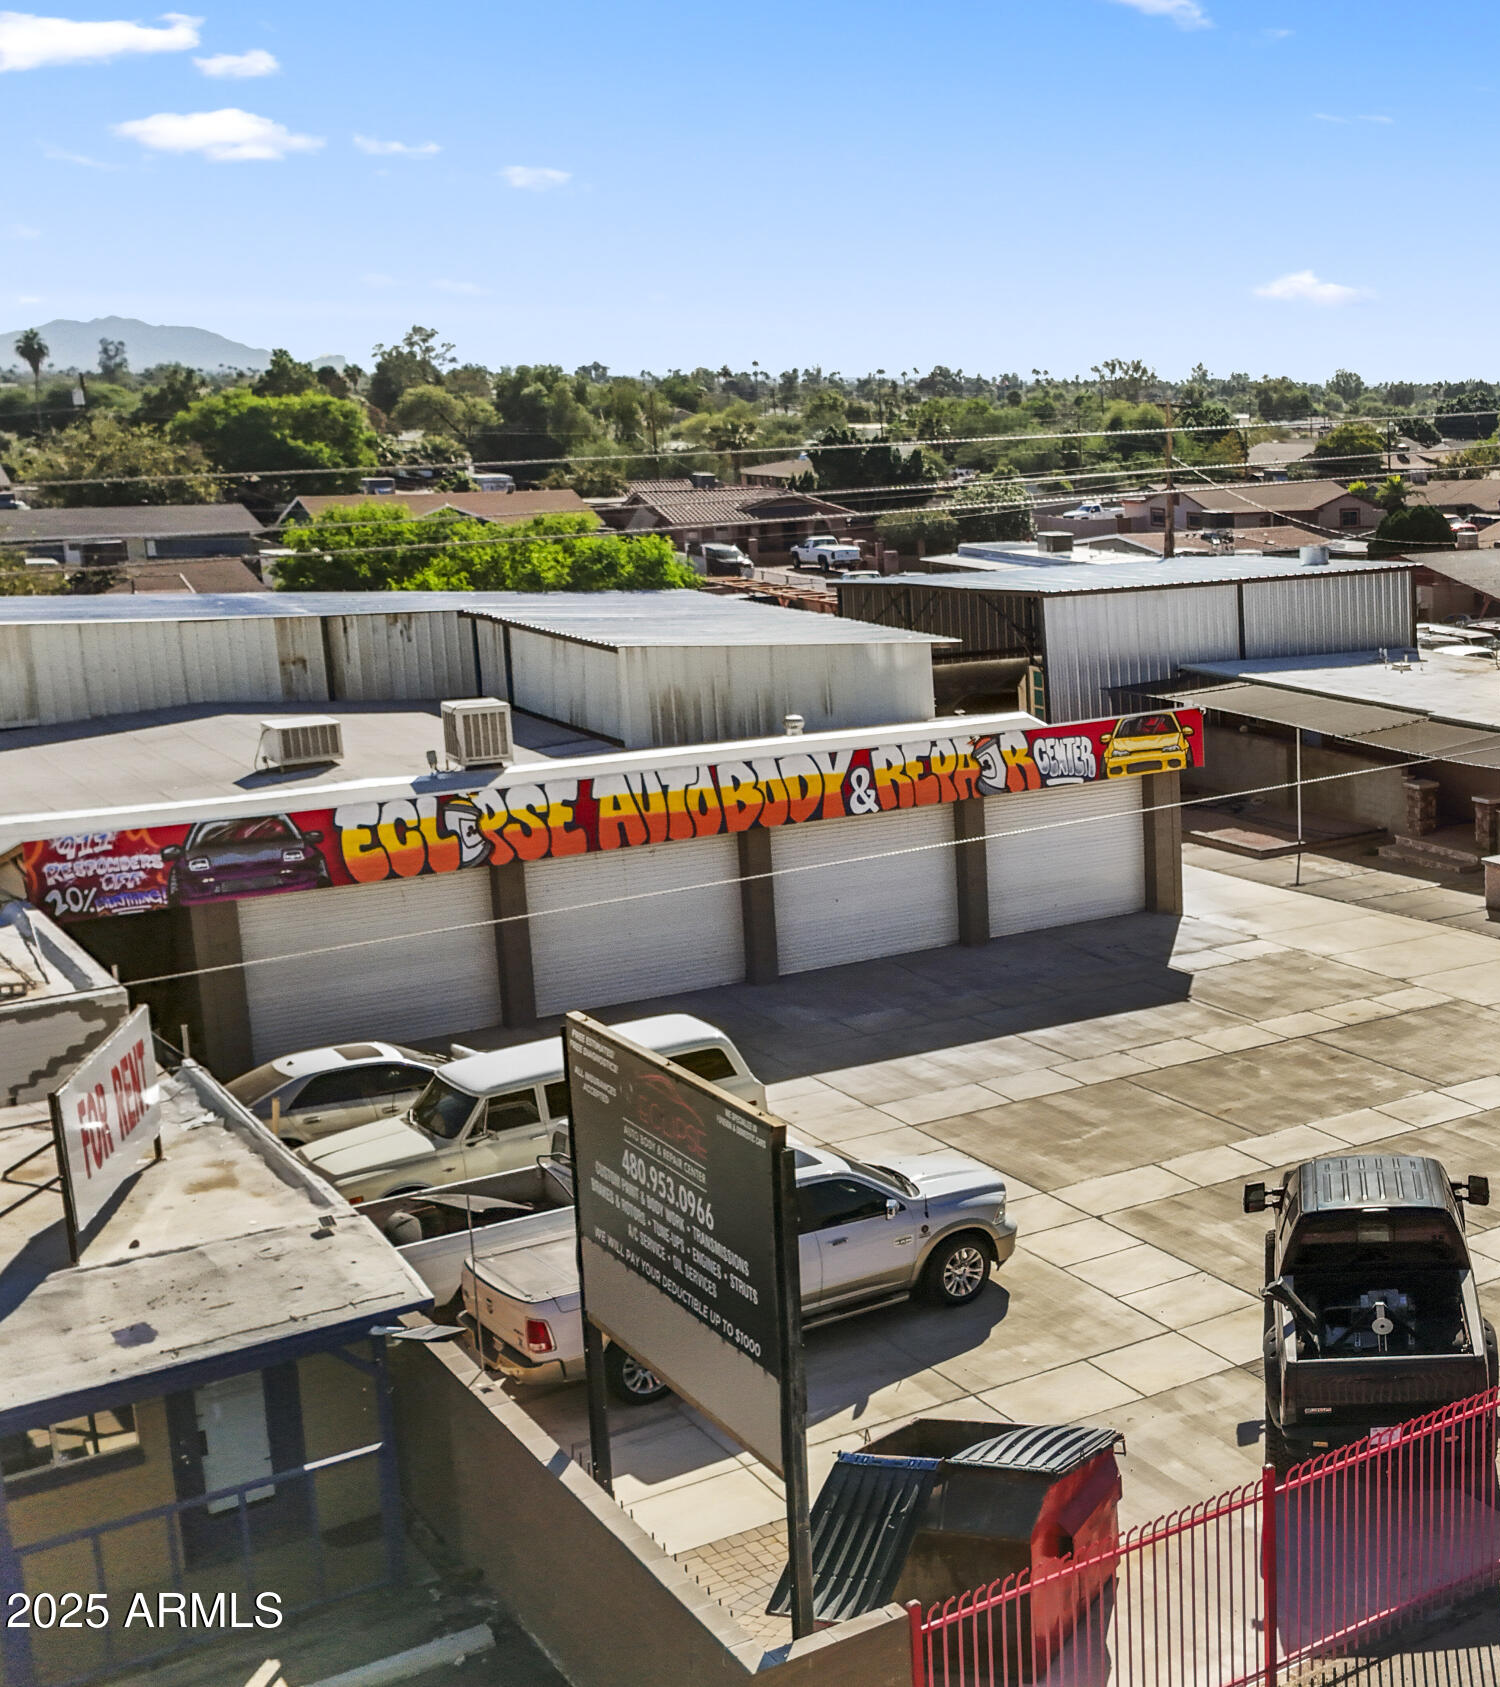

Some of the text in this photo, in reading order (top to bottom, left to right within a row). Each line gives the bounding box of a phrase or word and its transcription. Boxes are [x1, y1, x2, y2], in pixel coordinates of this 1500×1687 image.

[850, 767, 880, 814] &
[1033, 736, 1097, 778] CENTER
[43, 853, 164, 886] RESPONDERS
[45, 886, 97, 916] 20%
[101, 871, 147, 892] OFF
[77, 1038, 150, 1180] FOR RENT
[638, 1095, 708, 1160] ECLIPSE
[623, 1125, 639, 1142] AUTO
[640, 1134, 656, 1152] BODY
[662, 1148, 682, 1169] REPAIR
[684, 1162, 706, 1184] CENTER
[622, 1149, 715, 1231] 480.953.0966
[640, 1230, 666, 1261] SERVICE
[672, 1255, 684, 1274] OIL
[684, 1263, 718, 1298] SERVICES
[664, 1207, 686, 1232] WORK
[692, 1226, 750, 1277] TRANSMISSIONS
[594, 1225, 761, 1358] WE WILL PAY YOUR DEDUCTIBLE UP TO $1000
[692, 1247, 722, 1280] ENGINES
[730, 1273, 758, 1305] STRUTS
